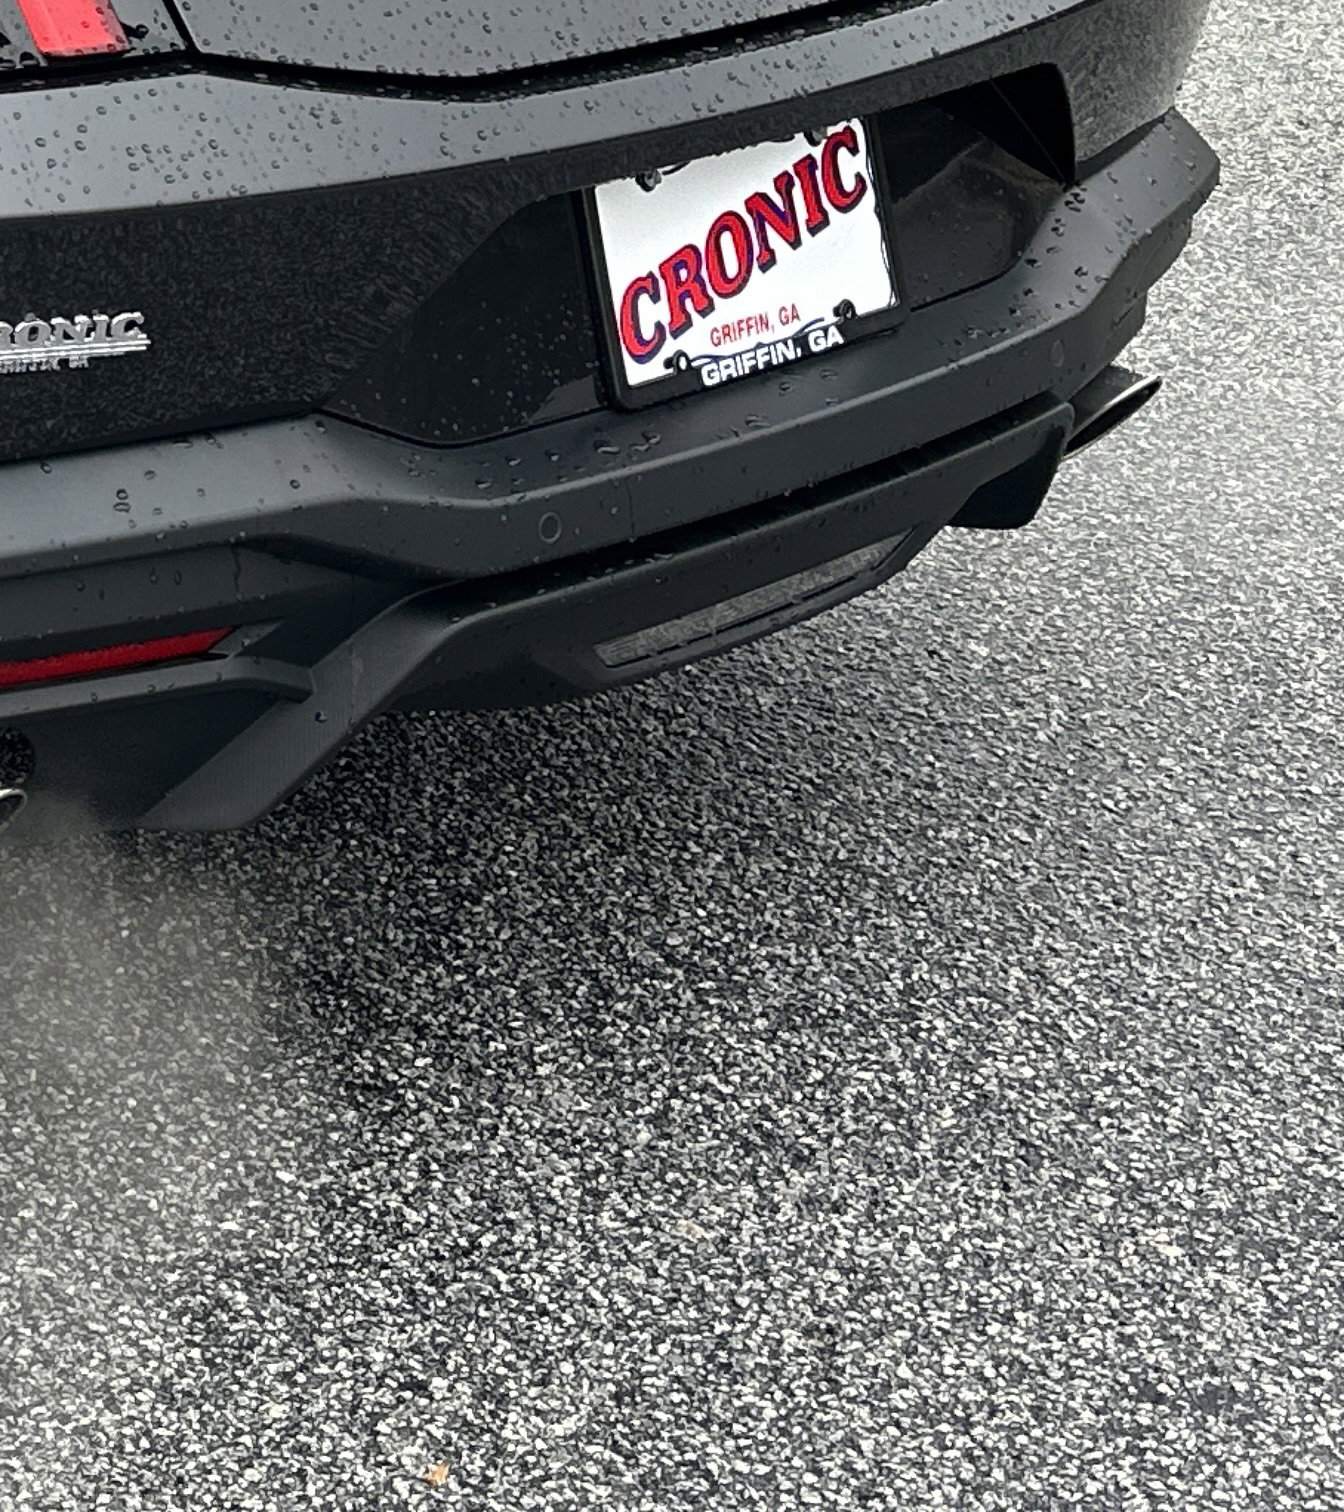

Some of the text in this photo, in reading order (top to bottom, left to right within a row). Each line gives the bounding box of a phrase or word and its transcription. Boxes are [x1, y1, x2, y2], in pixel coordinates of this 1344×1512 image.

[619, 125, 867, 364] CRONIC
[700, 325, 844, 387] GRIFFIN, GA
[710, 303, 801, 348] GRIFFIN, GA
